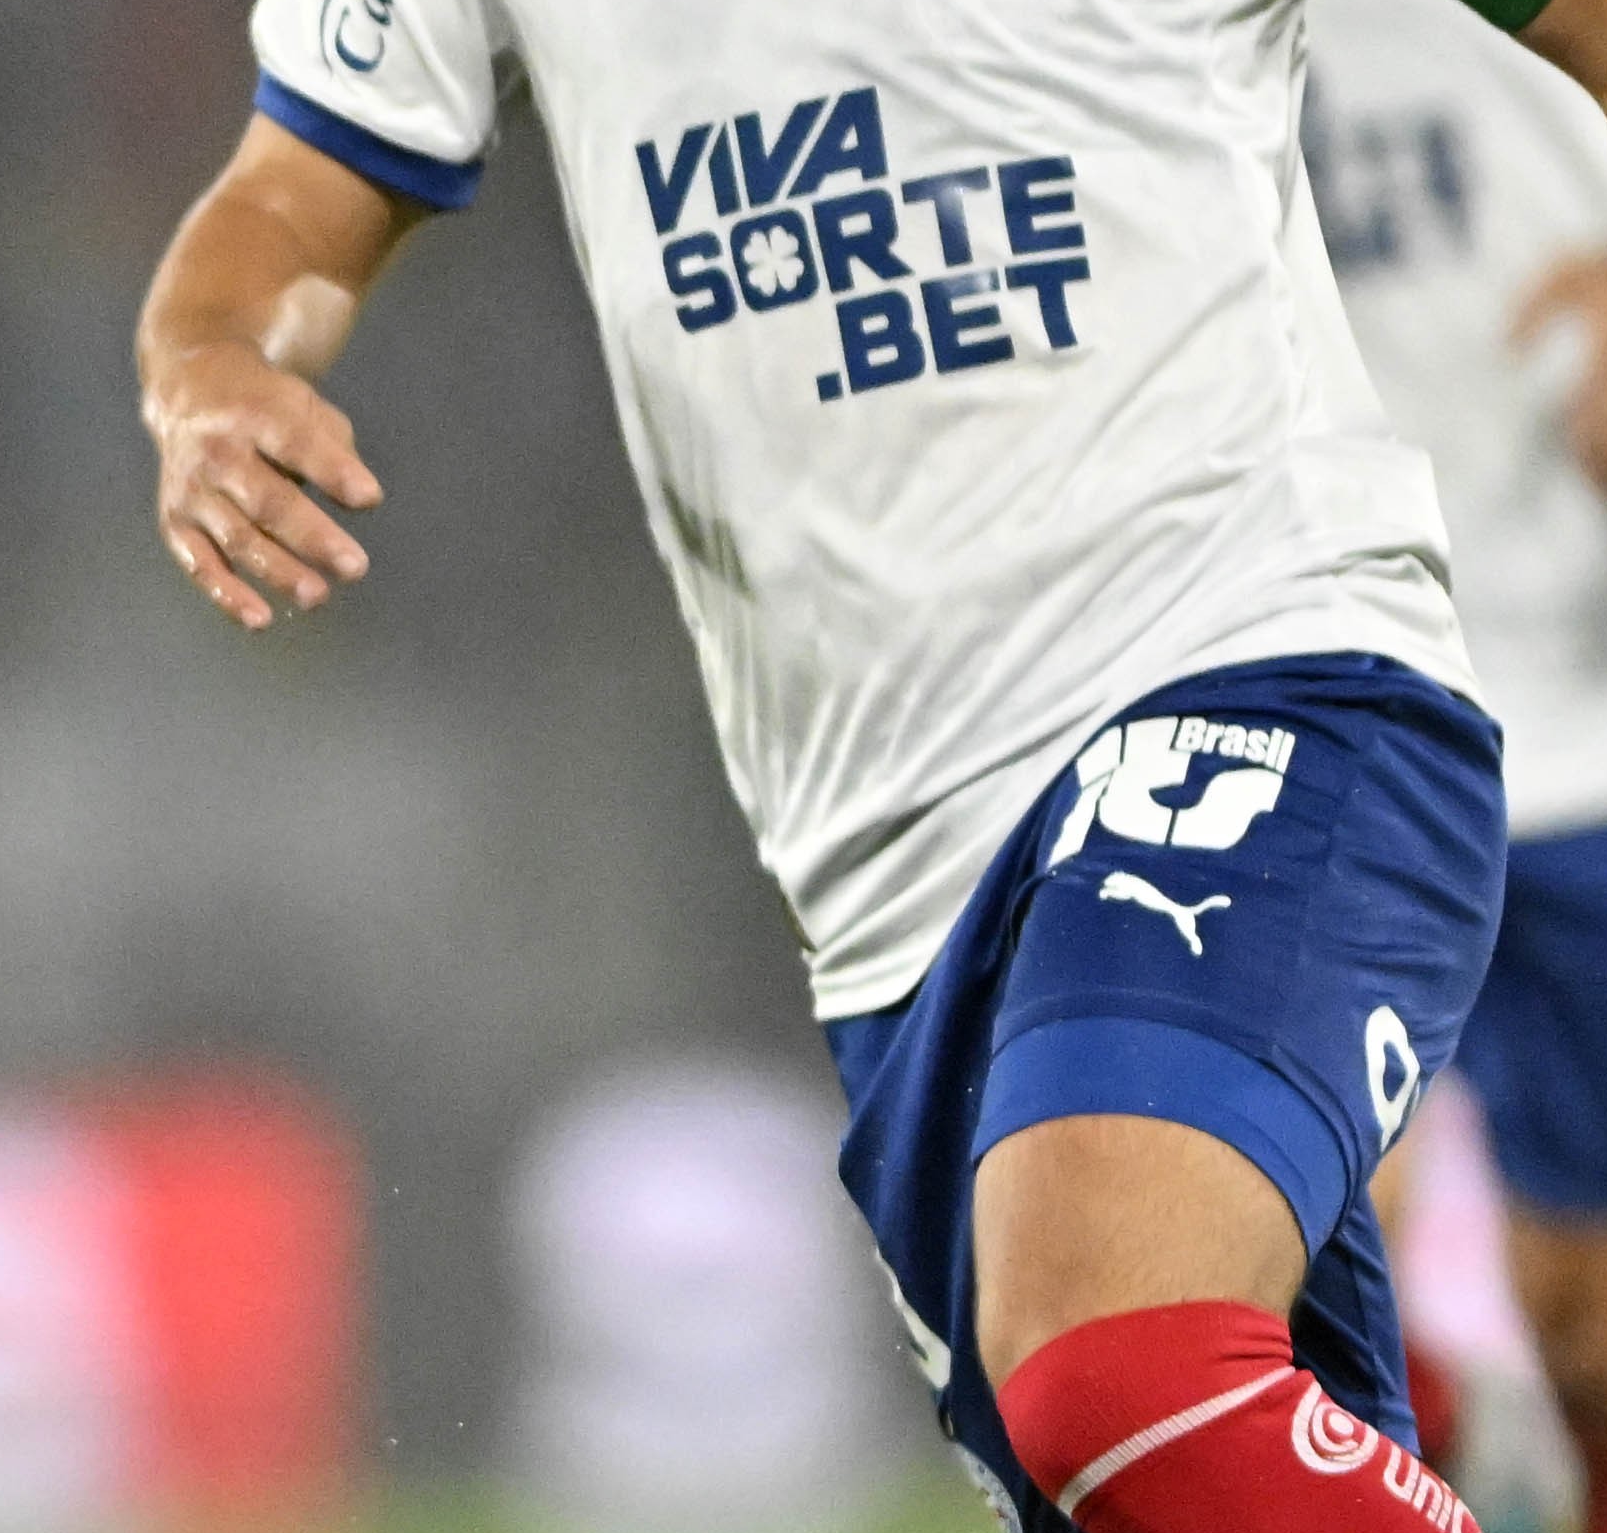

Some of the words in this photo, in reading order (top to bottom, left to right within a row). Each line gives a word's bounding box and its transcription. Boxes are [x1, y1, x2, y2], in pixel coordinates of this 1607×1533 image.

[634, 86, 890, 235] VIVA
[662, 154, 1087, 334] SORTE
[817, 256, 1091, 403] .BET
[1175, 717, 1296, 776] Brasil
